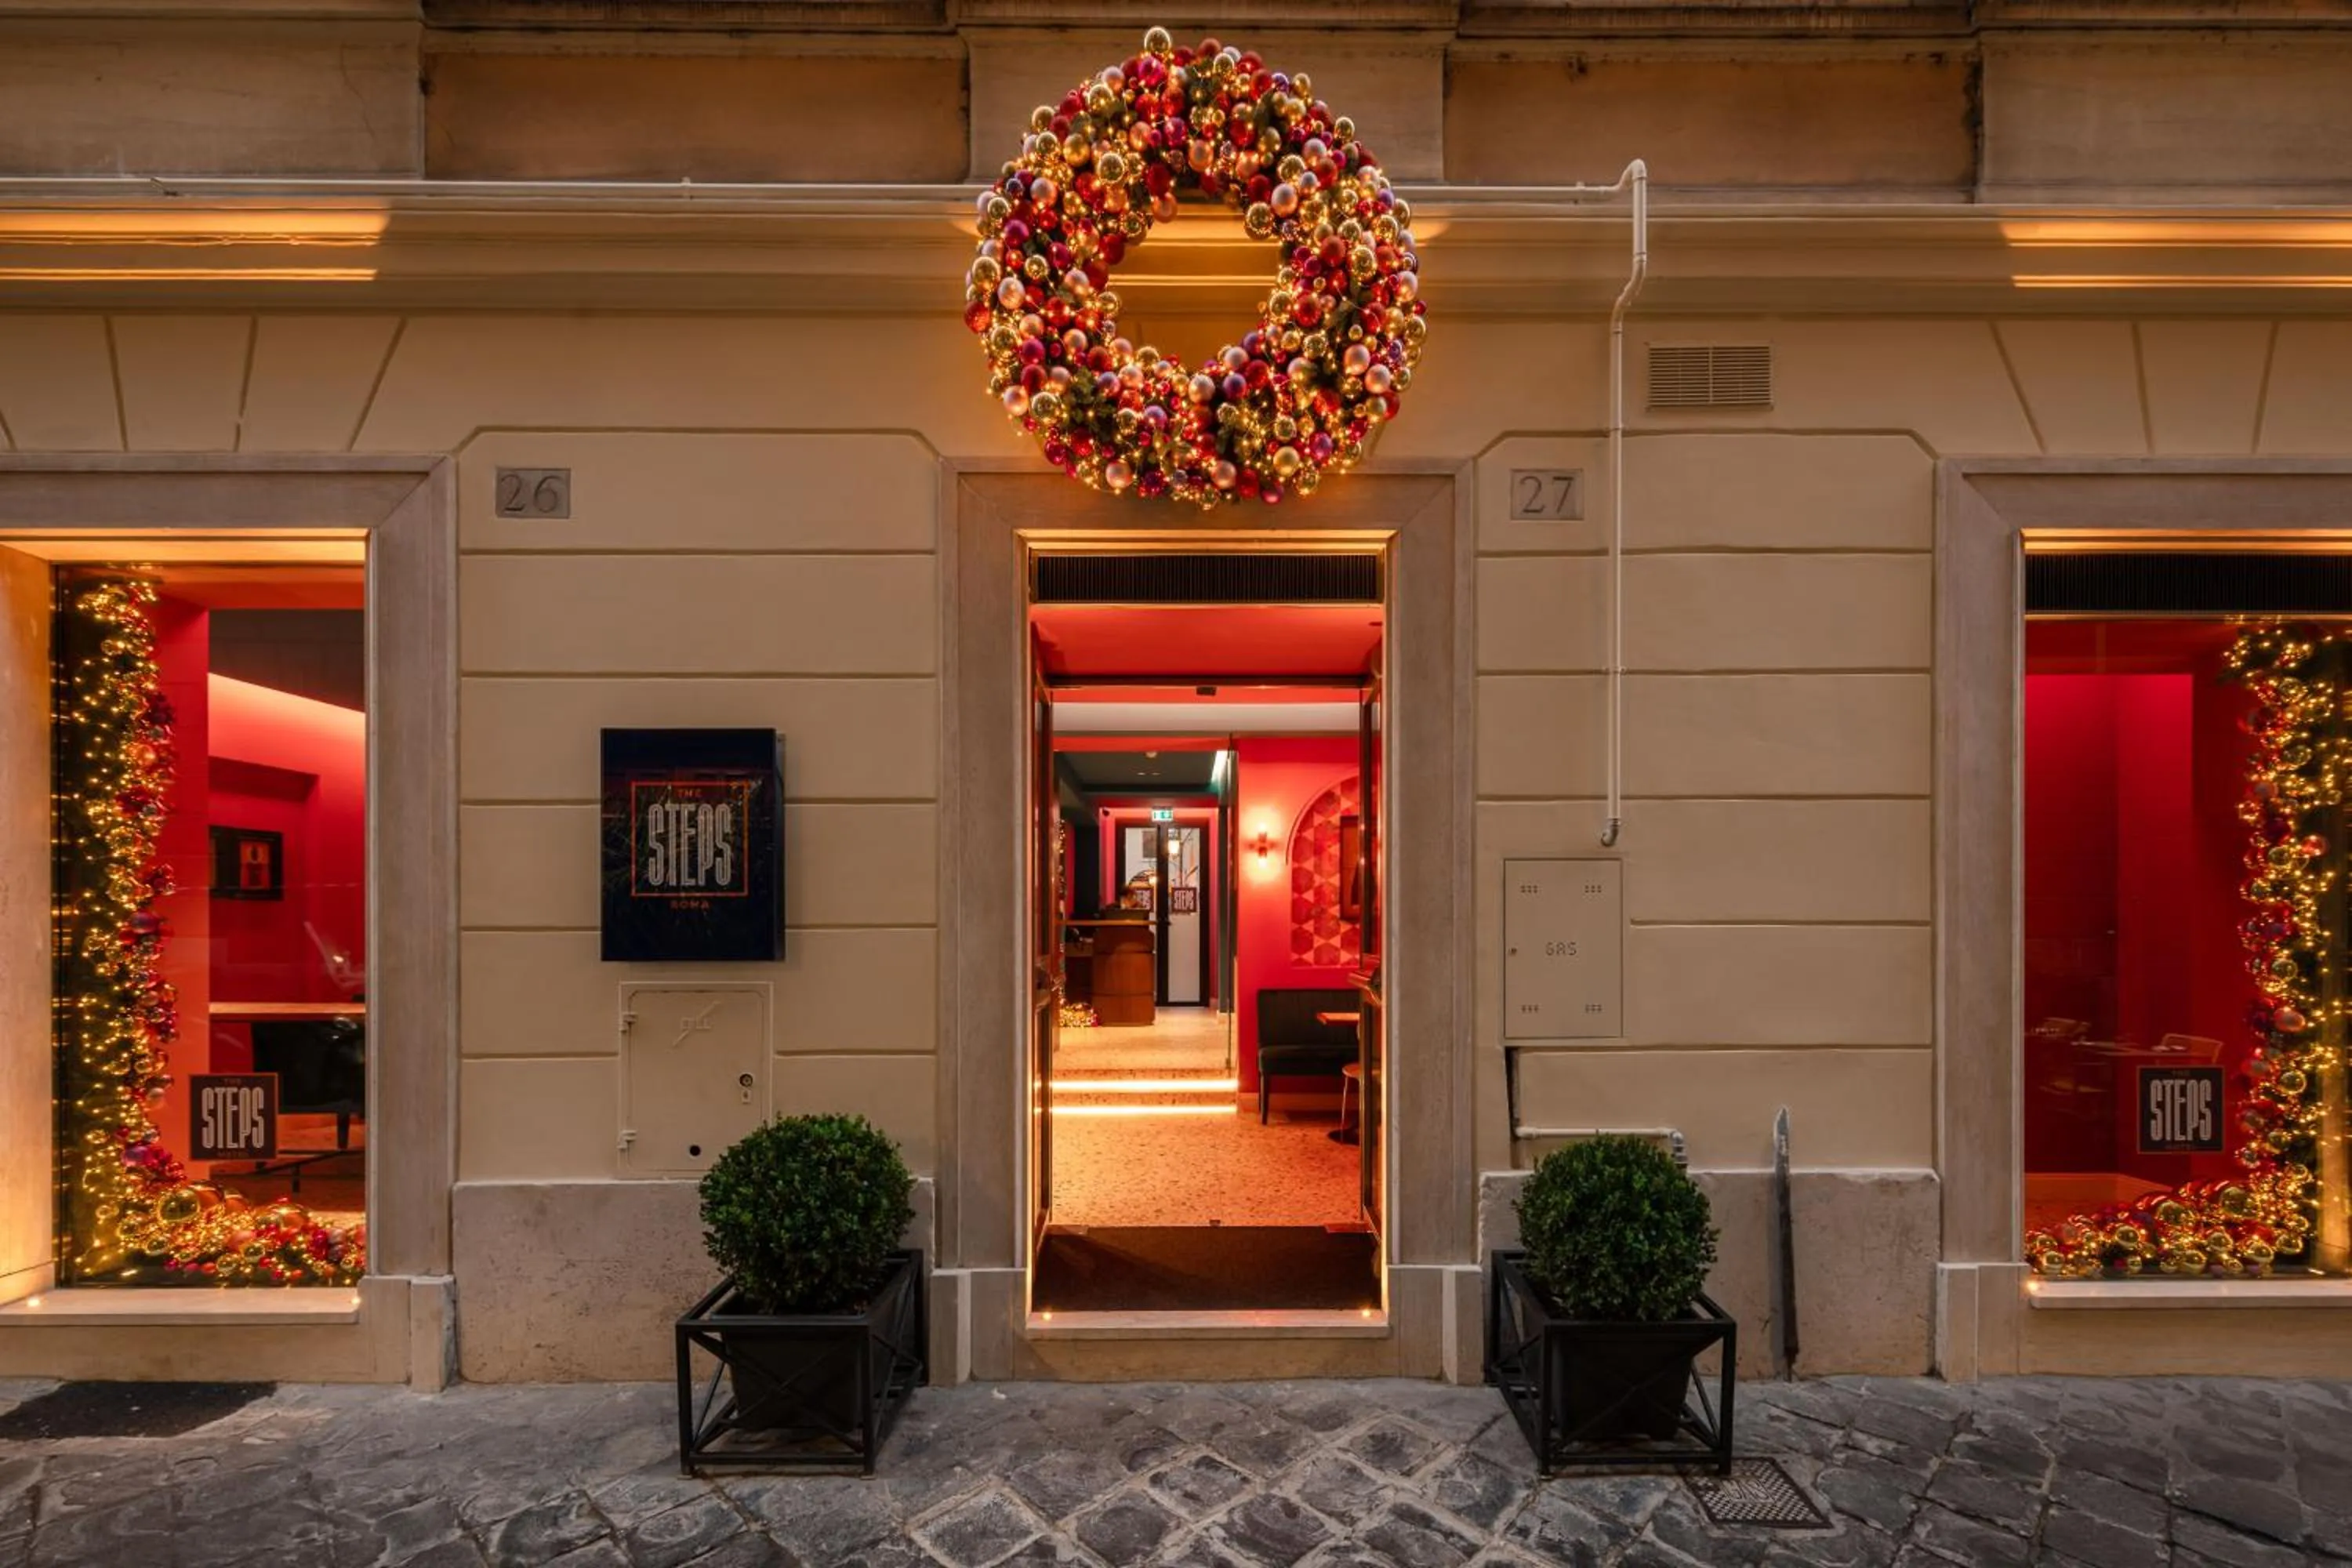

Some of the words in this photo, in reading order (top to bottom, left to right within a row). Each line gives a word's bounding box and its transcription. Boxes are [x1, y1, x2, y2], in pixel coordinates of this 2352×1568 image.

[501, 474, 561, 514] 26
[1519, 475, 1574, 514] 27
[648, 803, 732, 887] STEPS
[670, 901, 710, 910] ROMA
[1545, 942, 1577, 956] GAS
[201, 1087, 264, 1149] STEPS
[2151, 1080, 2212, 1141] STEPS
